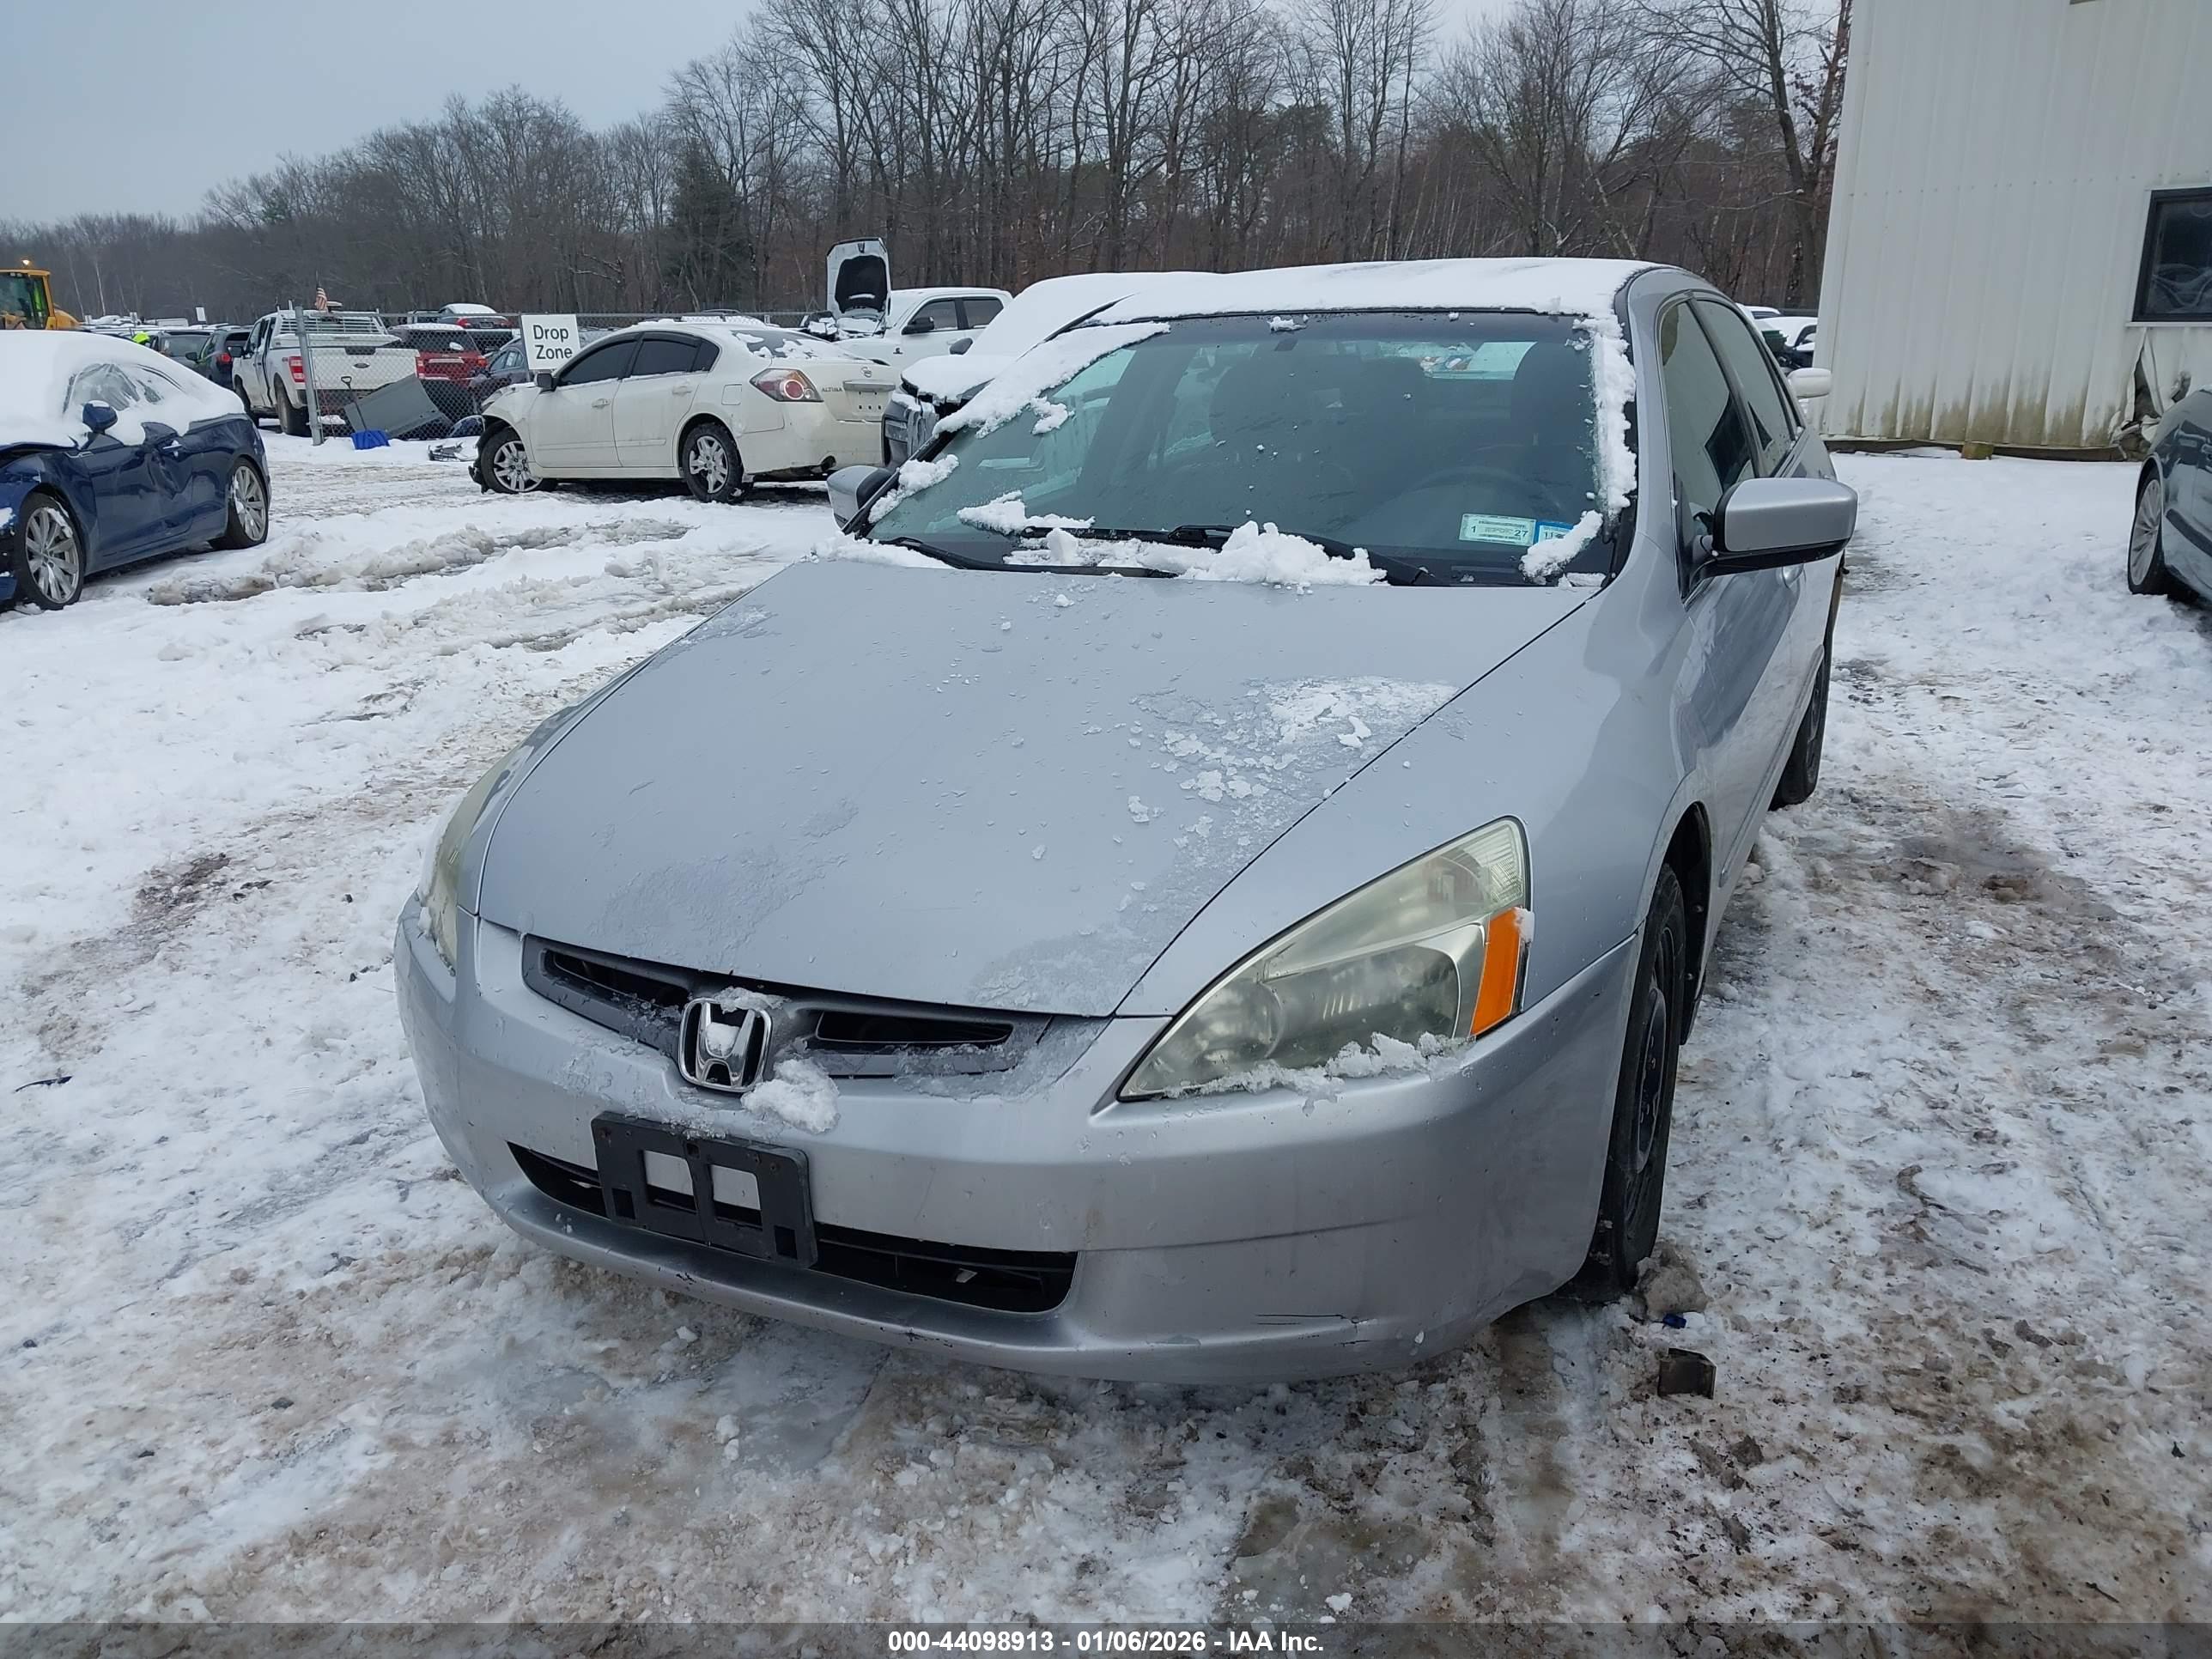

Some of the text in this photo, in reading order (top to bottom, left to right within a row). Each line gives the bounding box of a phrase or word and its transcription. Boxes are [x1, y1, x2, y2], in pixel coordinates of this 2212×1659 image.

[533, 325, 568, 342] Drop
[535, 344, 573, 360] Zone
[1514, 529, 1528, 538] 27
